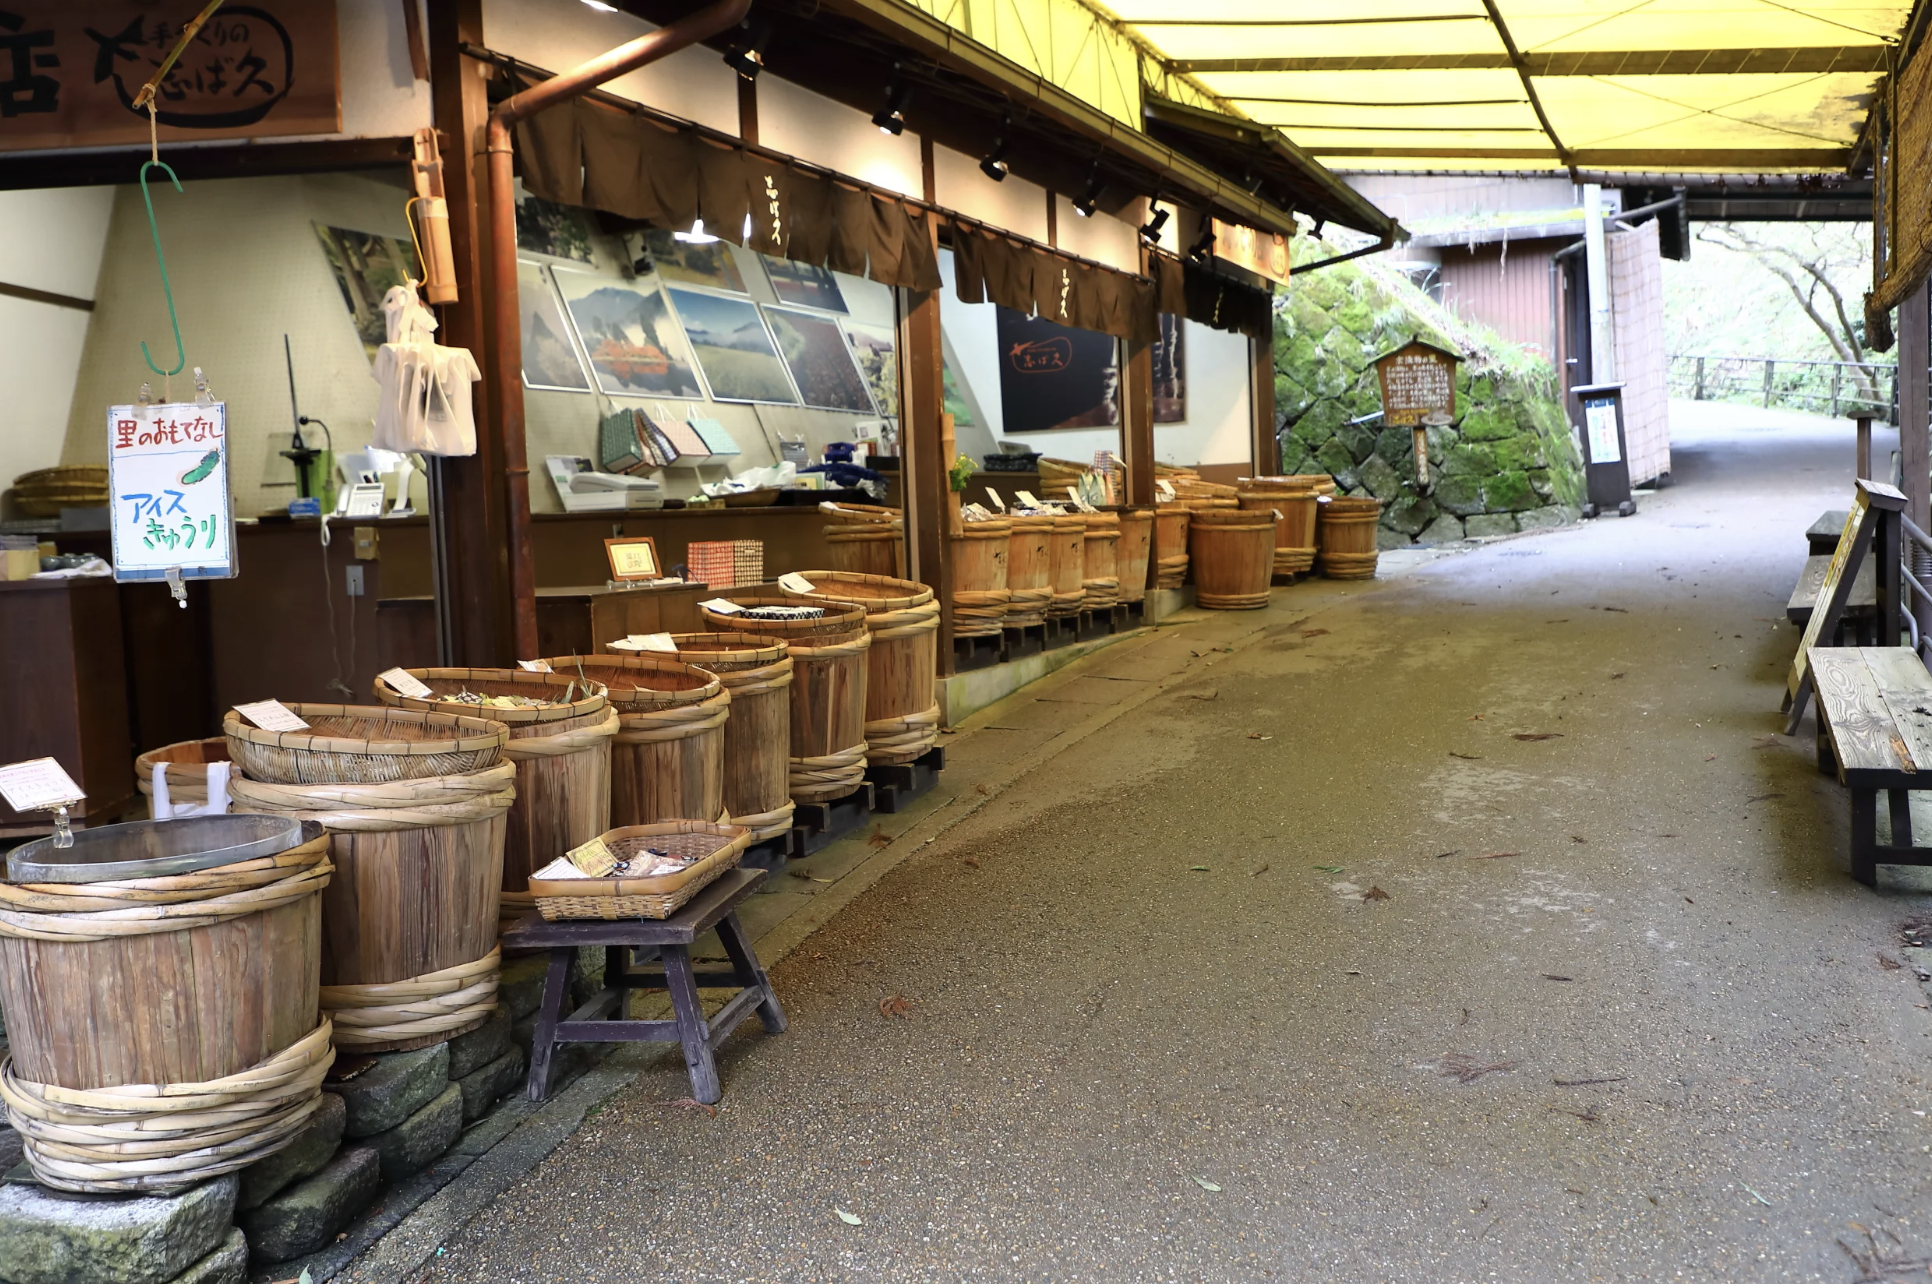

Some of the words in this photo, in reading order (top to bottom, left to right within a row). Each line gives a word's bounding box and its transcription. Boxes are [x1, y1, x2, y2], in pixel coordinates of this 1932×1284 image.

[115, 416, 224, 449] 里のおもてなし
[120, 489, 187, 523] アイス
[143, 514, 216, 550] きゅうり
